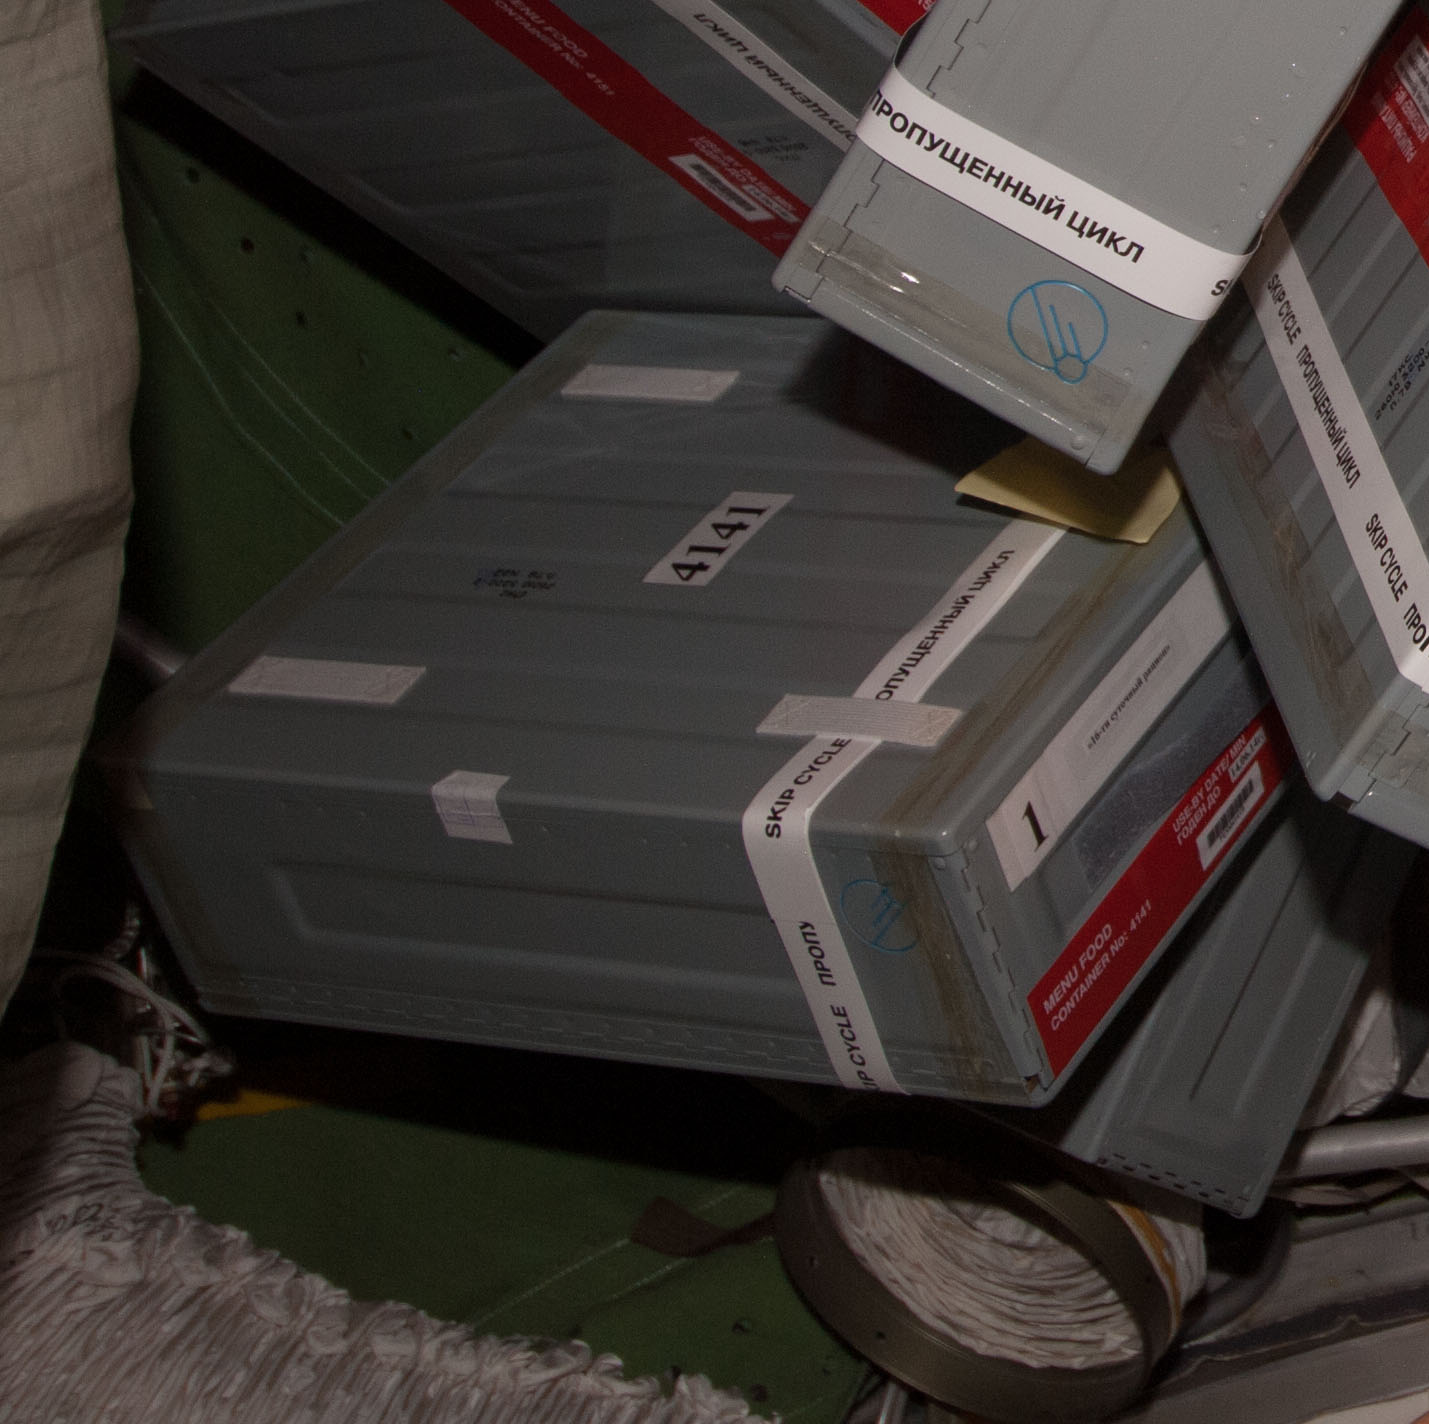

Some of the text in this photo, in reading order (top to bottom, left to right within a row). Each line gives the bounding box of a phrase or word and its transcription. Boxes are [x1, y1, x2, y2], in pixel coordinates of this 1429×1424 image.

[543, 26, 588, 58] FOOD
[693, 14, 749, 52] ЦИКЛ
[857, 88, 1066, 221] ПРОПУЩЕННЫЙ
[1066, 211, 1144, 263] ЦИКЛ
[1208, 274, 1230, 301] S
[1265, 269, 1302, 345] SKIP CYCLE
[1296, 344, 1360, 489] ПРОПУЩЕННЫЙ ЦИКЛ
[672, 506, 767, 582] 4141
[970, 550, 1015, 591] ЦИКЛ
[1366, 513, 1408, 602] SKIP CYCLE
[765, 739, 852, 838] SKIP CYCLE
[1172, 787, 1212, 832] USE-BY
[1175, 783, 1227, 845] ГОДЕН ДО
[1024, 801, 1048, 849] 1
[799, 921, 836, 986] ПРОПУ
[1043, 923, 1122, 1014] MENU FOOD
[1044, 899, 1152, 1031] CONTAINER No: 4141
[830, 1004, 866, 1066] CYCLE
